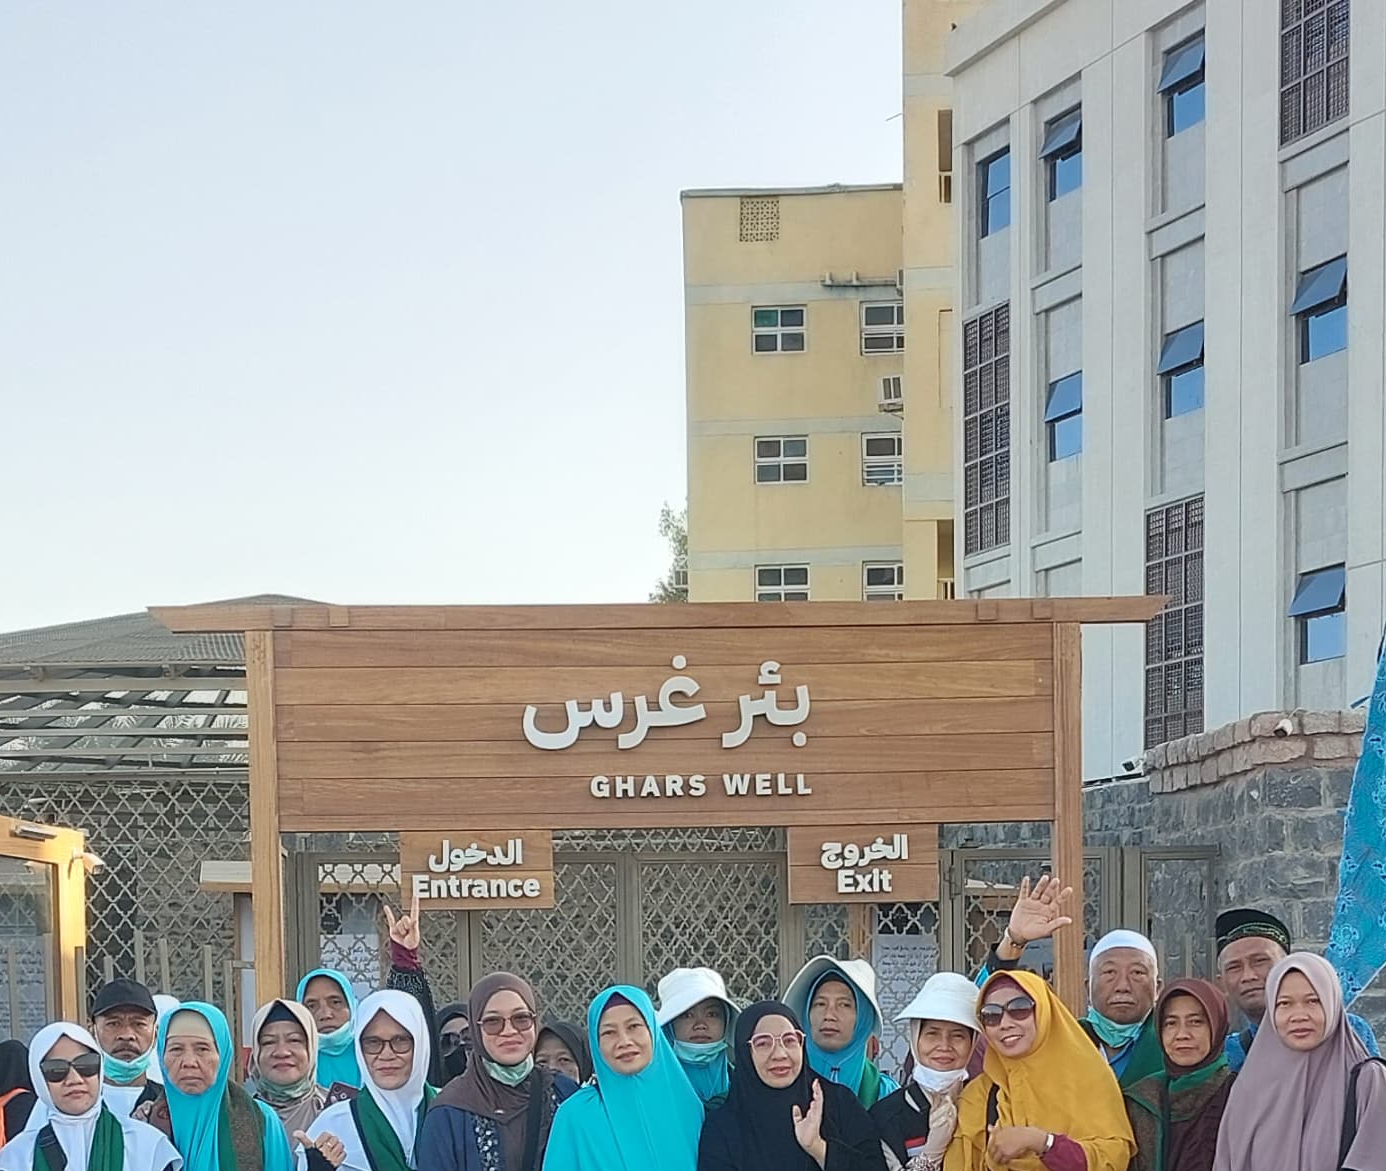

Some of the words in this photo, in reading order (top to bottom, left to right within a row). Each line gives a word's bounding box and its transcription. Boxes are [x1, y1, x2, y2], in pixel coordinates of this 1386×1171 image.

[522, 655, 708, 750] غرس
[721, 660, 811, 749] بئر
[590, 774, 707, 798] GHARS
[723, 772, 813, 796] WELL
[428, 838, 524, 873] الدخول
[820, 833, 910, 870] الخروج
[412, 875, 541, 899] Entrance
[836, 868, 893, 894] Exit
